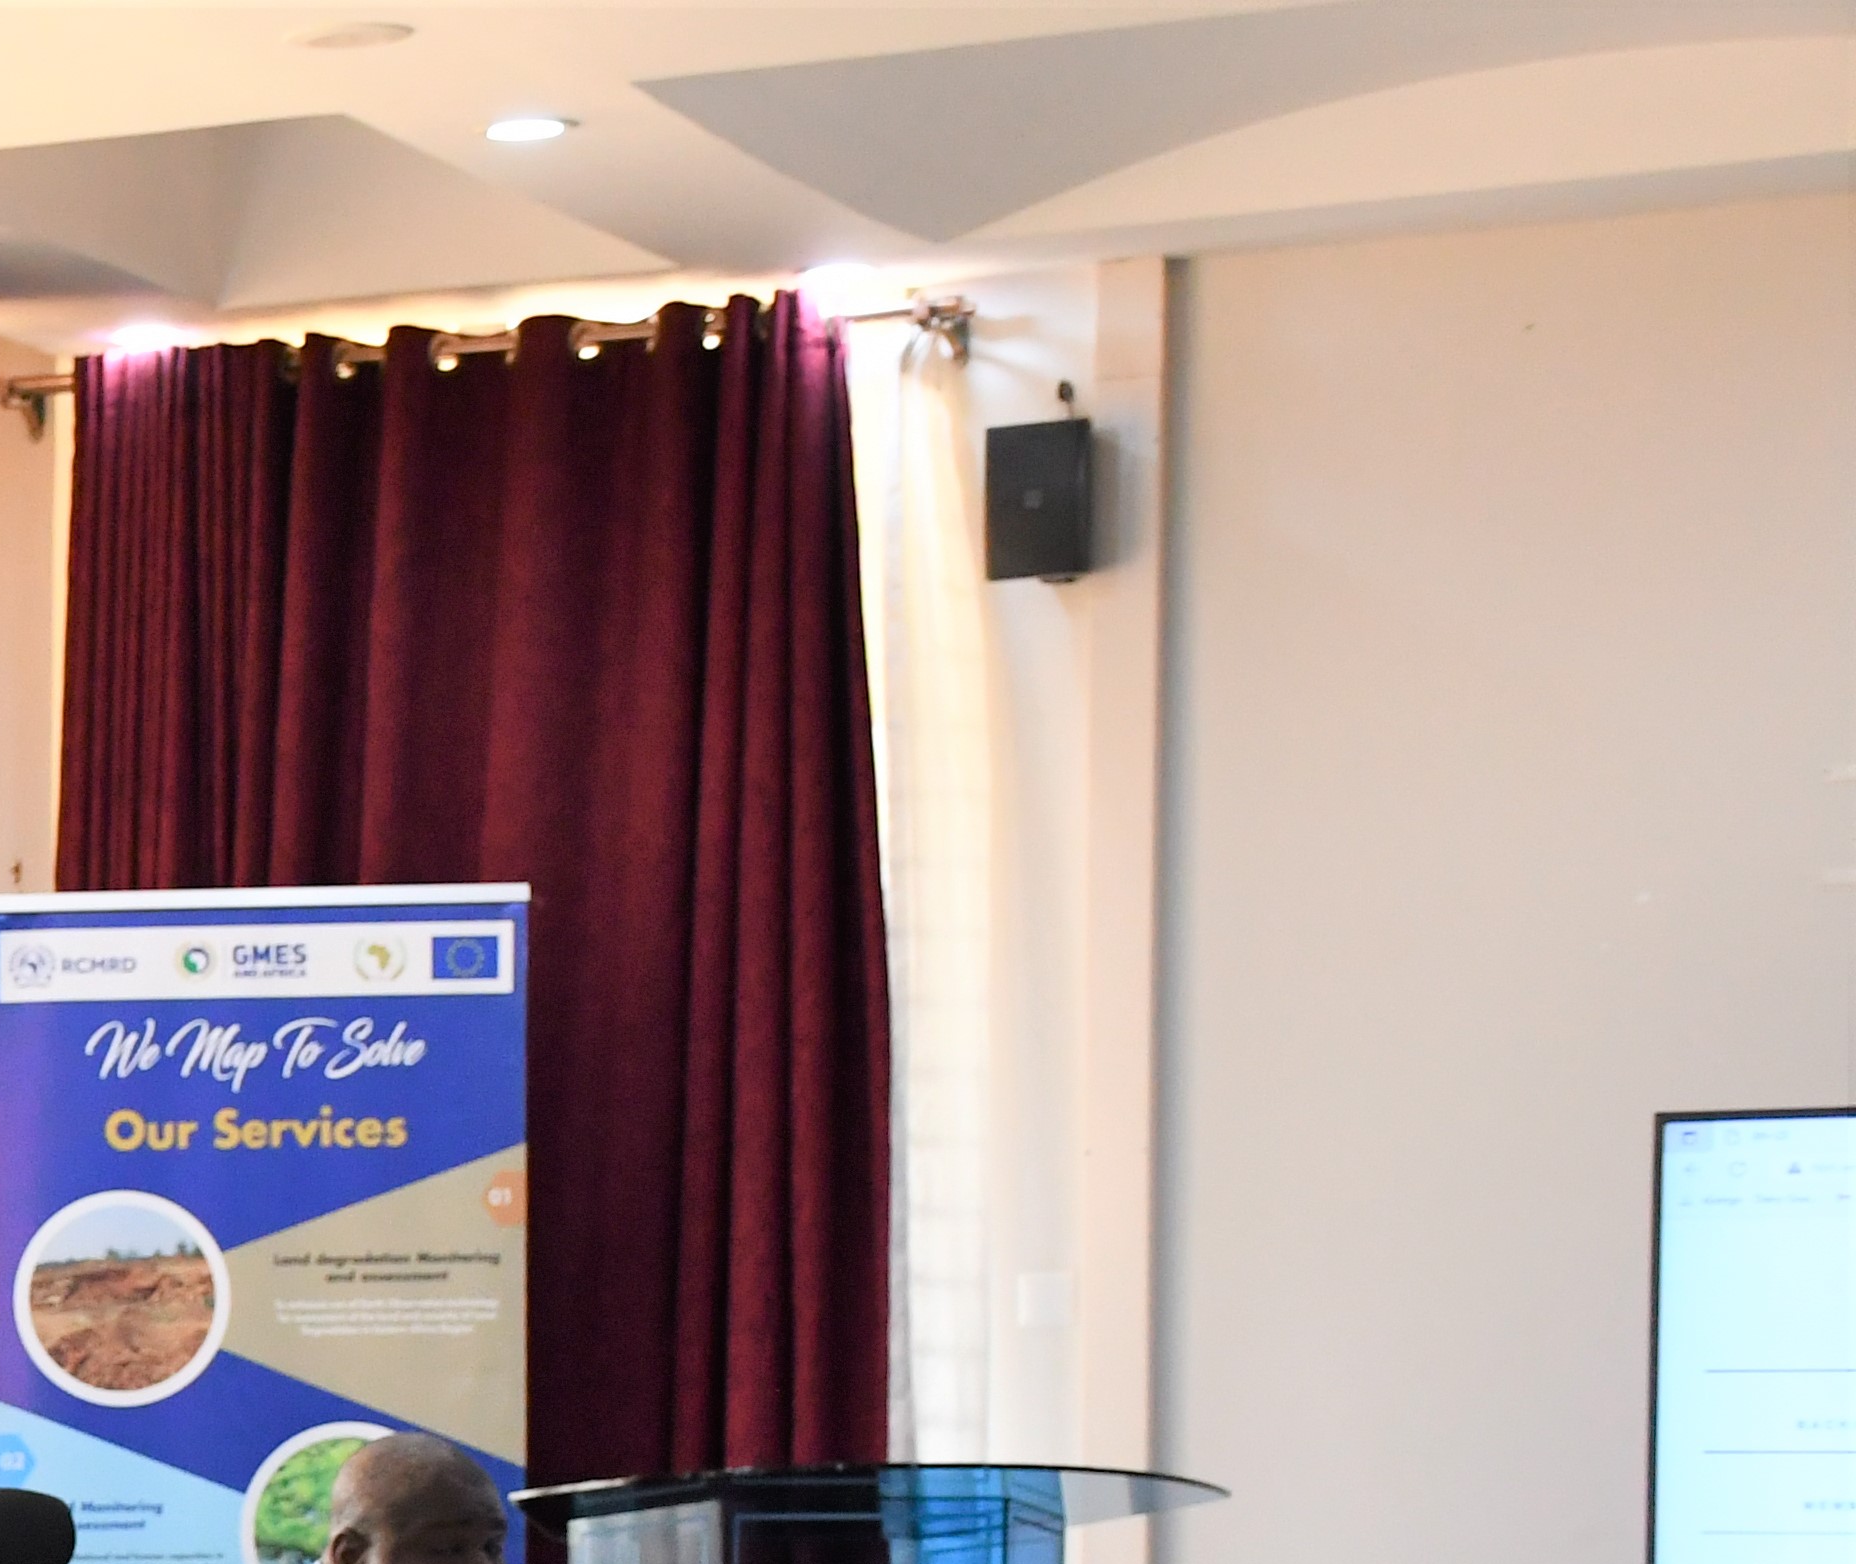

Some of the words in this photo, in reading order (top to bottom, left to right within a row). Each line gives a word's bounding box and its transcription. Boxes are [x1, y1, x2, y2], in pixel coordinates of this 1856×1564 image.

[232, 943, 307, 966] GMES
[84, 1017, 162, 1080] We
[164, 1018, 268, 1093] Map
[272, 1016, 338, 1079] To
[323, 1016, 427, 1080] Solve
[104, 1108, 198, 1152] Our
[212, 1104, 408, 1151] Services
